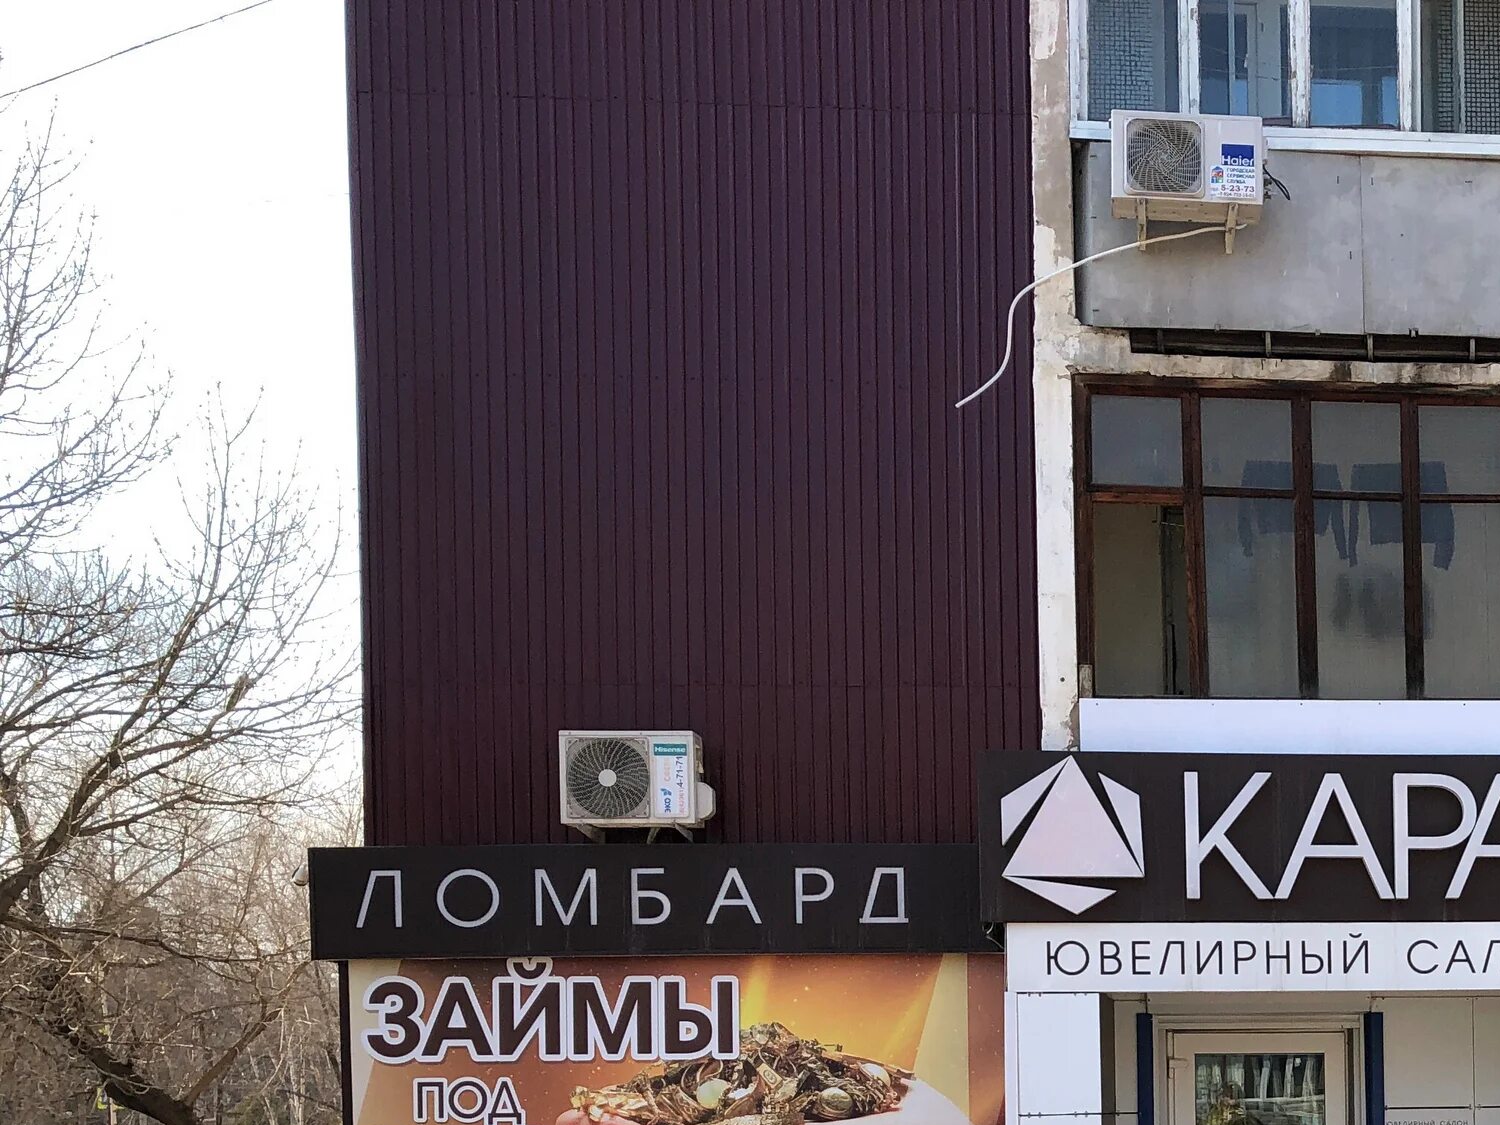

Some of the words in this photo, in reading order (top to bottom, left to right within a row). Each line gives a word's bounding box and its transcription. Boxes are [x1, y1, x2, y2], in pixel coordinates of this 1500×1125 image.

[1222, 155, 1254, 165] Haier
[1220, 184, 1255, 192] 5-23-73
[355, 866, 910, 929] ЛОМБАРД
[1045, 932, 1371, 976] ЮВЕЛИРНЫЙ
[366, 957, 739, 1061] ЗАЙМЫ
[415, 1079, 524, 1125] ПОД
